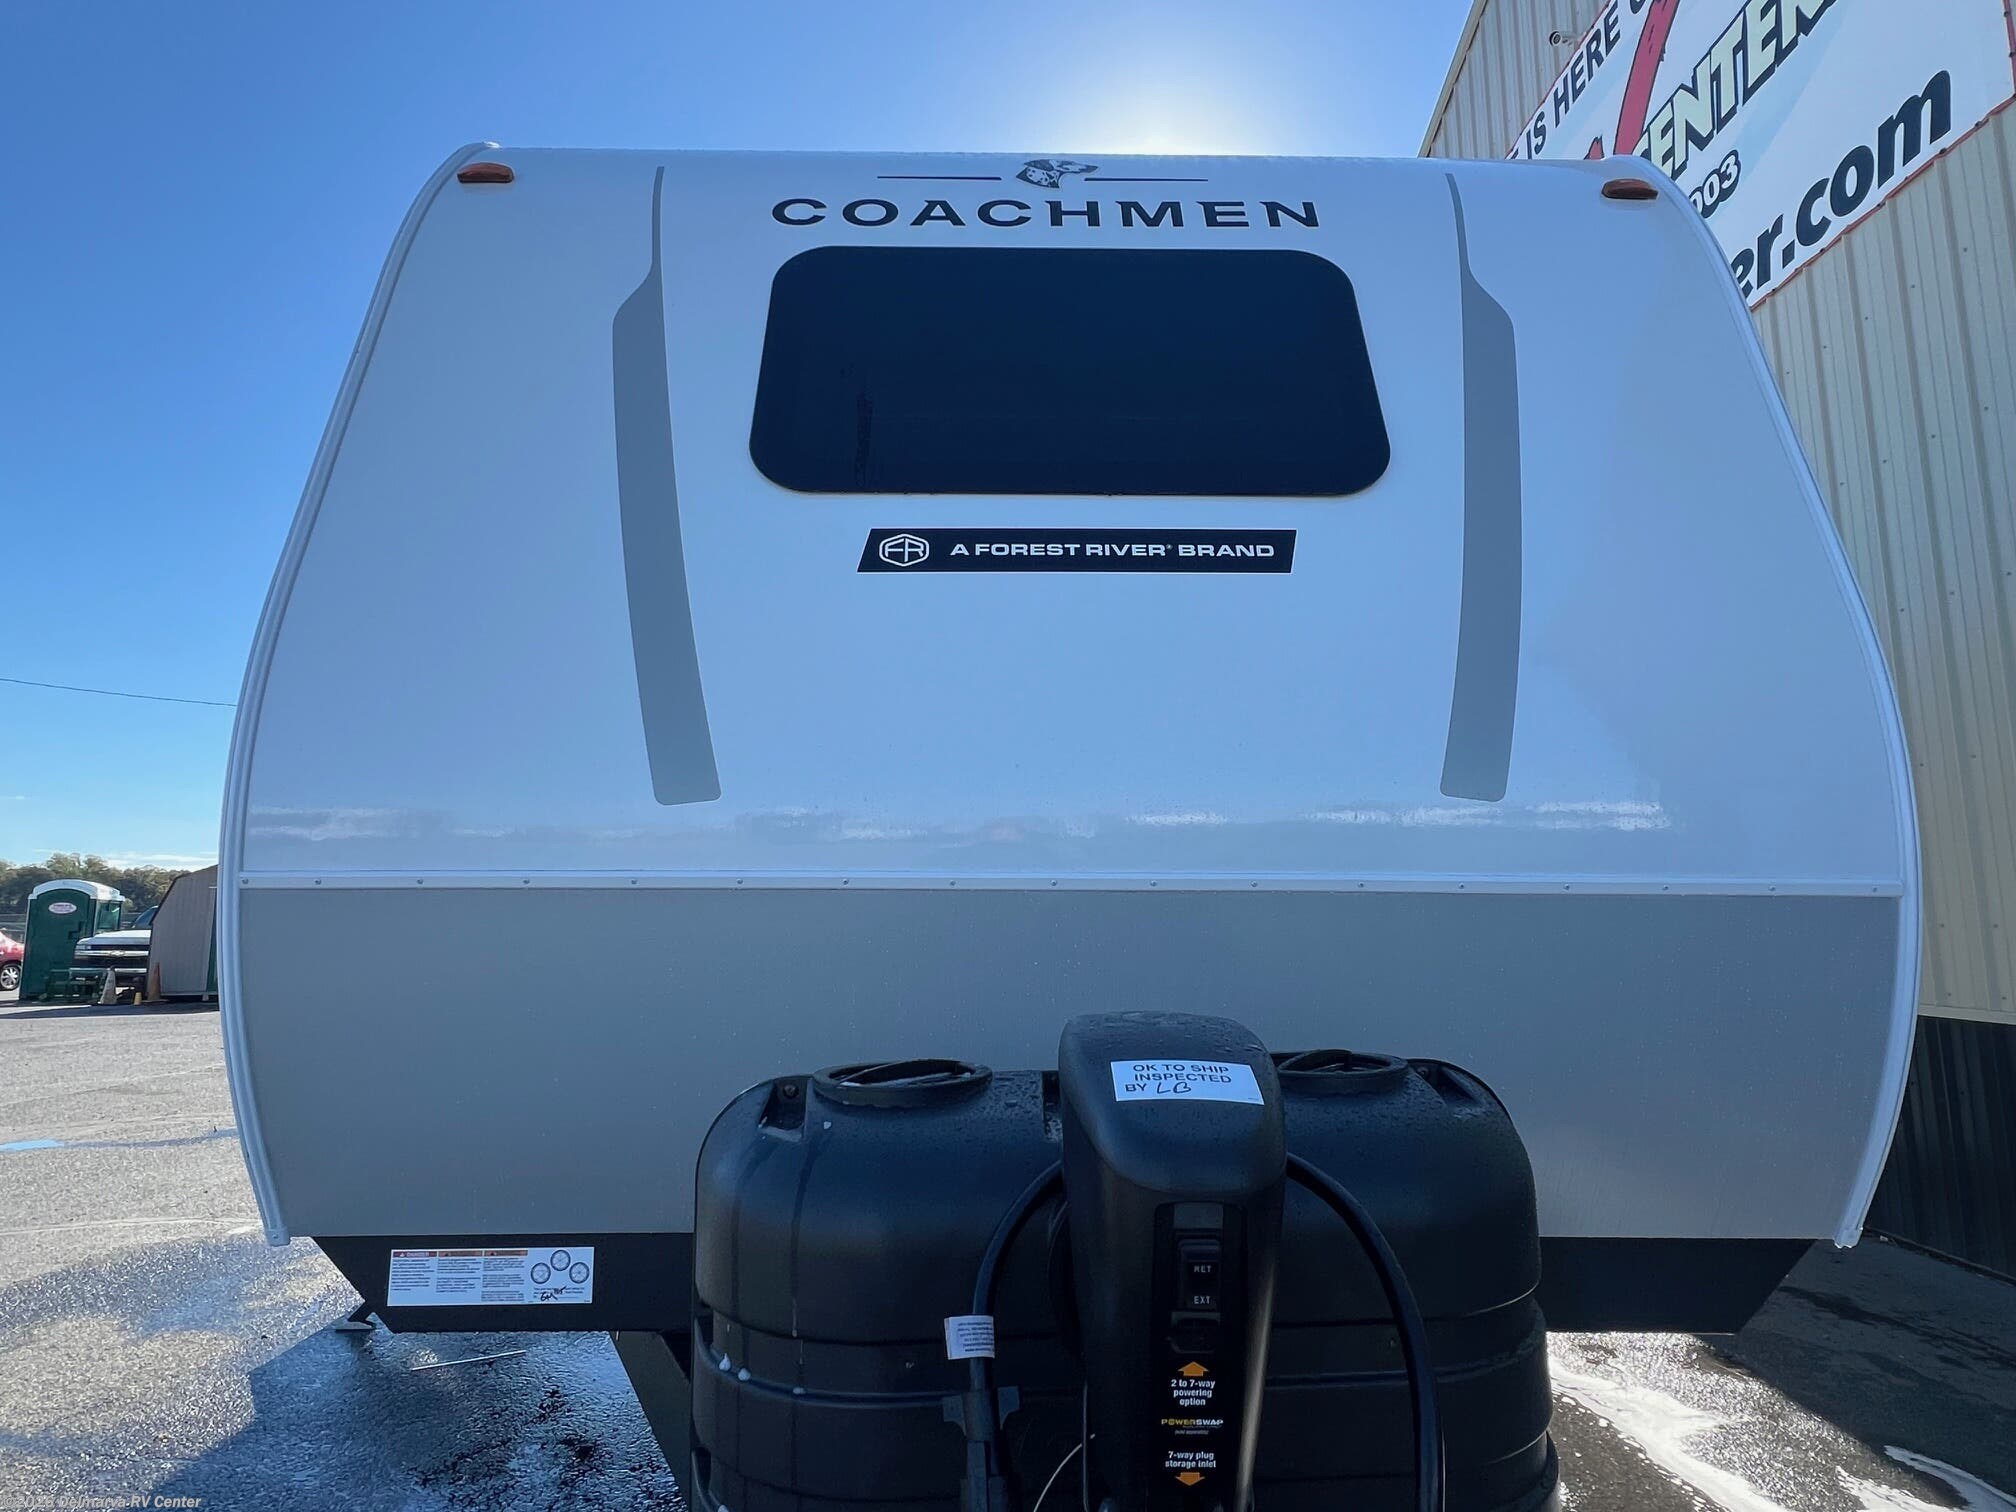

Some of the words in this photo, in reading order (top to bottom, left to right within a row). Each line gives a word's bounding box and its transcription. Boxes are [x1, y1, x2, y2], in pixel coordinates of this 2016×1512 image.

[1526, 111, 1547, 160] IS
[1553, 0, 1621, 128] HERE
[771, 199, 1320, 228] COACHMEN
[950, 544, 970, 556] A
[975, 544, 1081, 556] FOREST
[1179, 545, 1275, 557] BRAND
[1133, 1064, 1158, 1072] OK
[1162, 1064, 1186, 1072] TO
[1191, 1065, 1229, 1073] SHIP
[1134, 1073, 1232, 1083] INSPECTED
[1125, 1083, 1147, 1092] BY
[1194, 1296, 1211, 1304] EXT
[1171, 1380, 1177, 1388] 2
[1179, 1380, 1188, 1388] to
[1189, 1380, 1216, 1389] 7-way
[1173, 1389, 1213, 1398] powering
[1179, 1398, 1206, 1406] option
[1168, 1451, 1193, 1460] 7-way
[1195, 1452, 1214, 1460] plug
[1165, 1460, 1196, 1469] storage
[1198, 1460, 1217, 1468] inlet
